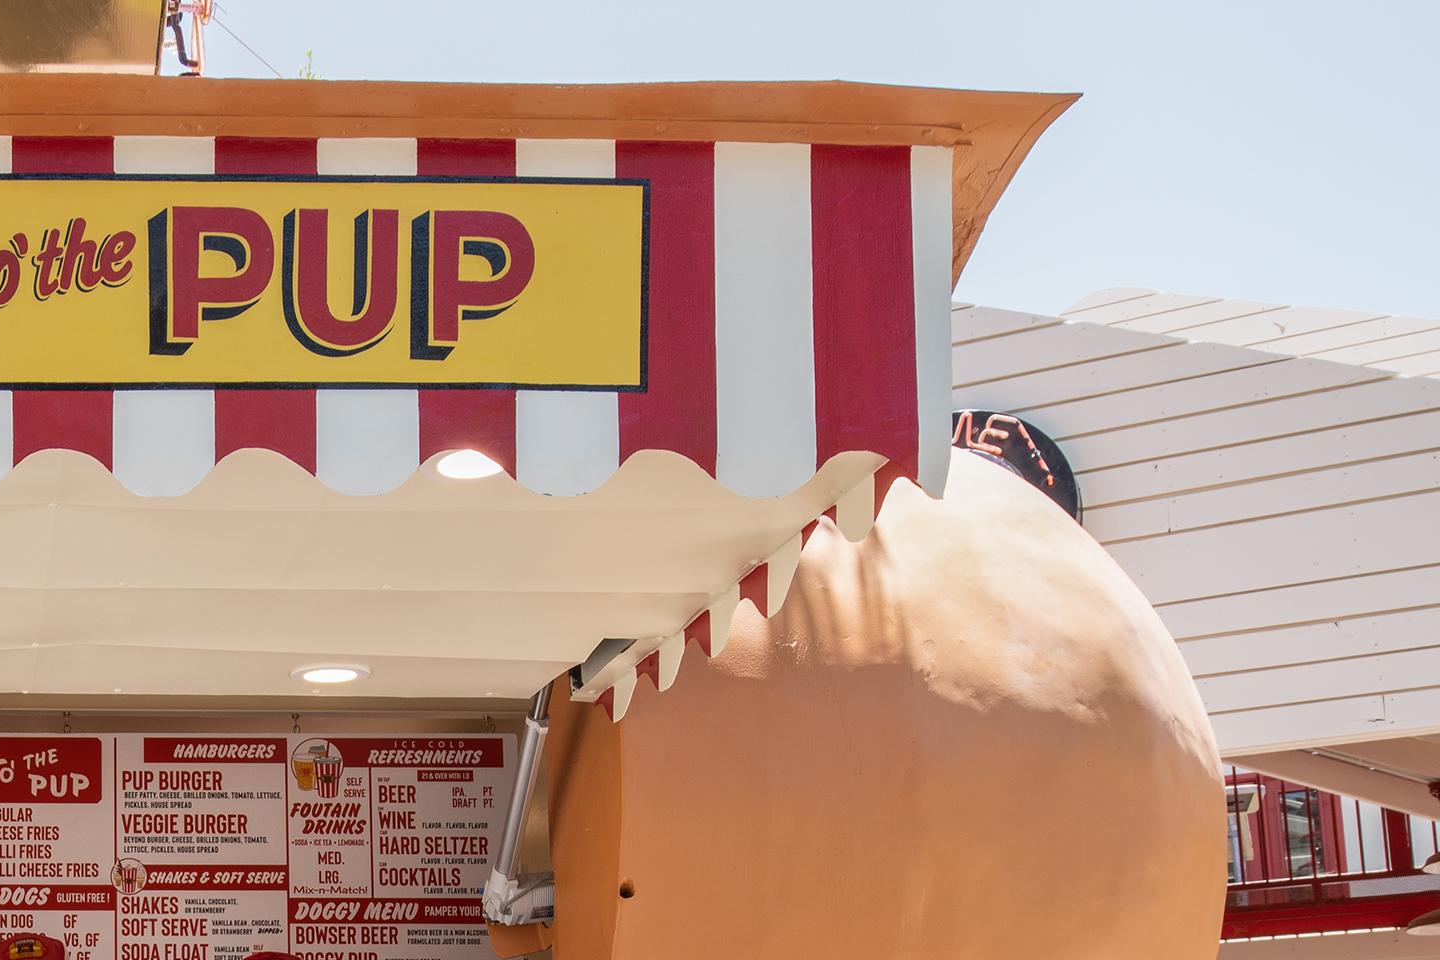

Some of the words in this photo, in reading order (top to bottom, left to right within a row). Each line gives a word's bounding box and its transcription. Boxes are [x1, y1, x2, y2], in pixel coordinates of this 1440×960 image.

[147, 206, 536, 361] PUP
[173, 744, 276, 759] HAMBURGERS
[368, 750, 482, 764] REFRESHMENTS
[23, 749, 58, 770] THE
[28, 773, 90, 797] PUP
[122, 771, 154, 790] PUP
[160, 771, 222, 790] BURGER
[346, 778, 362, 786] SELF
[344, 789, 366, 797] SERVE
[378, 785, 416, 803] BEER
[483, 787, 494, 797] PT.
[290, 803, 361, 817] FOUTAIN
[452, 798, 477, 808] DRAFT
[483, 798, 495, 808] PT.
[122, 814, 178, 834] VEGGIE
[184, 814, 247, 834] BURGER
[303, 819, 366, 834] DRINKS
[379, 811, 416, 829] WINE
[27, 826, 59, 841] FRIES
[19, 845, 51, 859] FRIES
[380, 836, 420, 855] HARD
[425, 837, 488, 855] SELTZER
[318, 852, 344, 865] MED.
[19, 863, 63, 877] CHEESE
[67, 863, 99, 877] FRIES
[319, 871, 342, 884] LRG.
[379, 868, 461, 886] COCKTAILS
[148, 872, 196, 884] SHAKES
[199, 872, 210, 884] &
[213, 872, 244, 884] SOFT
[247, 872, 285, 884] SERVE
[294, 886, 368, 894] Mix-n-Match!
[57, 893, 85, 903] GLUTEN
[122, 897, 179, 914] SHAKES
[295, 902, 361, 920] DOGGY
[364, 903, 419, 920] MENU
[425, 906, 458, 916] PAMPER
[460, 906, 480, 917] YOUR
[11, 914, 33, 928] DOG
[63, 915, 77, 929] GF
[122, 919, 157, 936] SOFT
[162, 919, 208, 936] SERVE
[63, 933, 82, 948] VG,
[87, 933, 99, 947] GF
[296, 926, 356, 945] BOWSER
[361, 927, 398, 945] BEER
[122, 944, 160, 960] SODA
